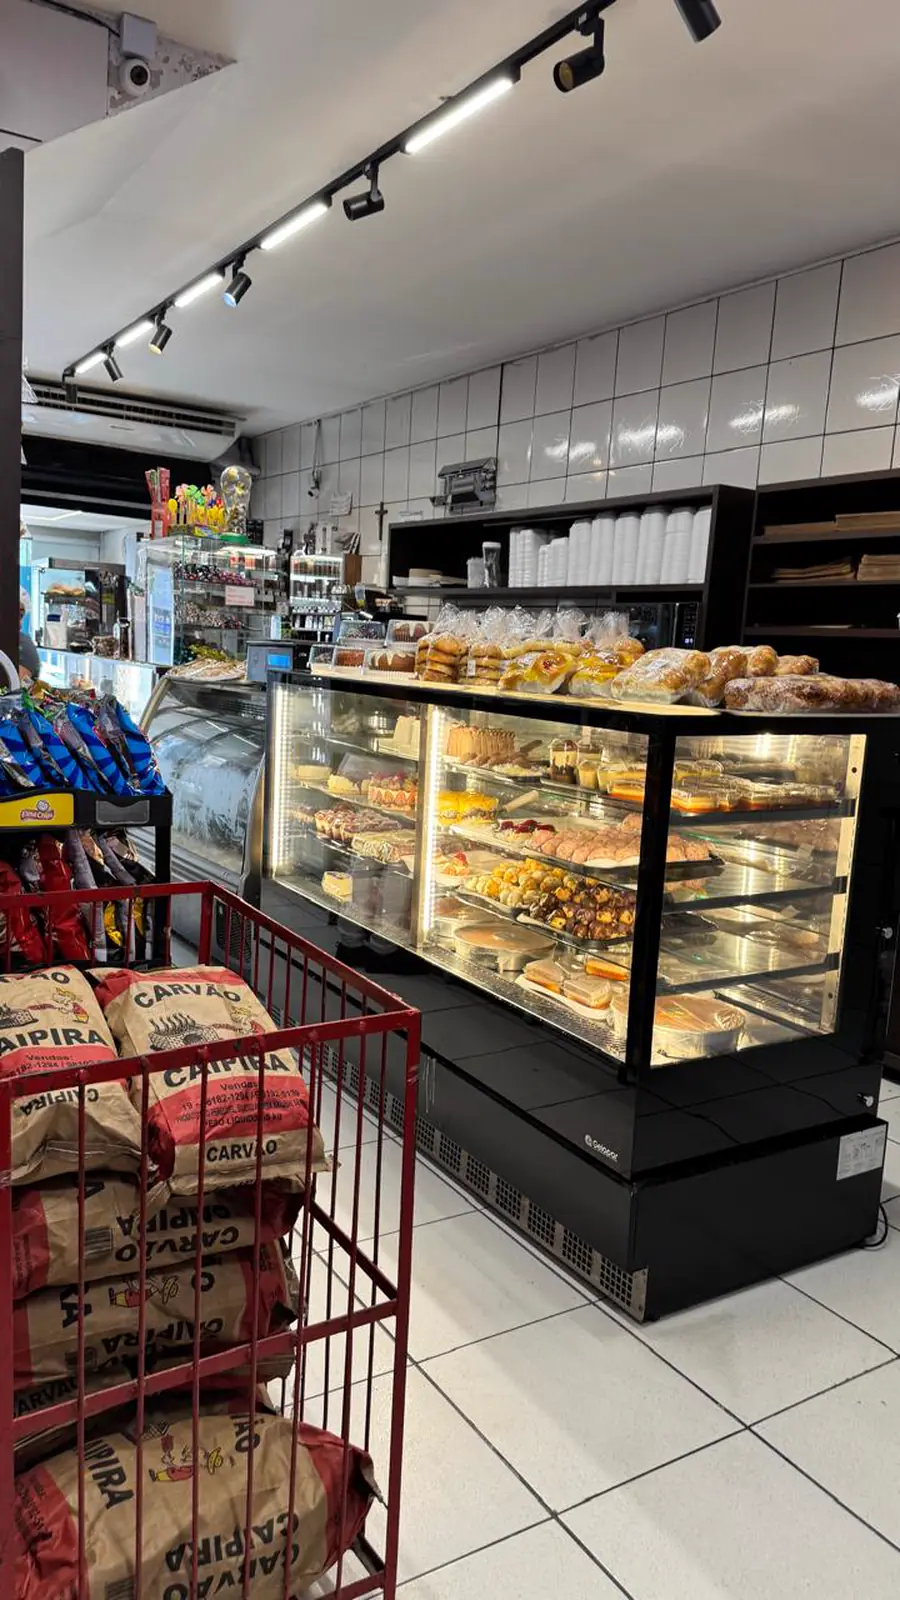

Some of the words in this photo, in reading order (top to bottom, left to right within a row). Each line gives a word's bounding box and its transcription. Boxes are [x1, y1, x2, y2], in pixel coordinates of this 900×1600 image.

[134, 983, 241, 1009] CARVÃO
[0, 1028, 109, 1055] AIPIRA
[166, 1513, 299, 1572] CAPIRA
